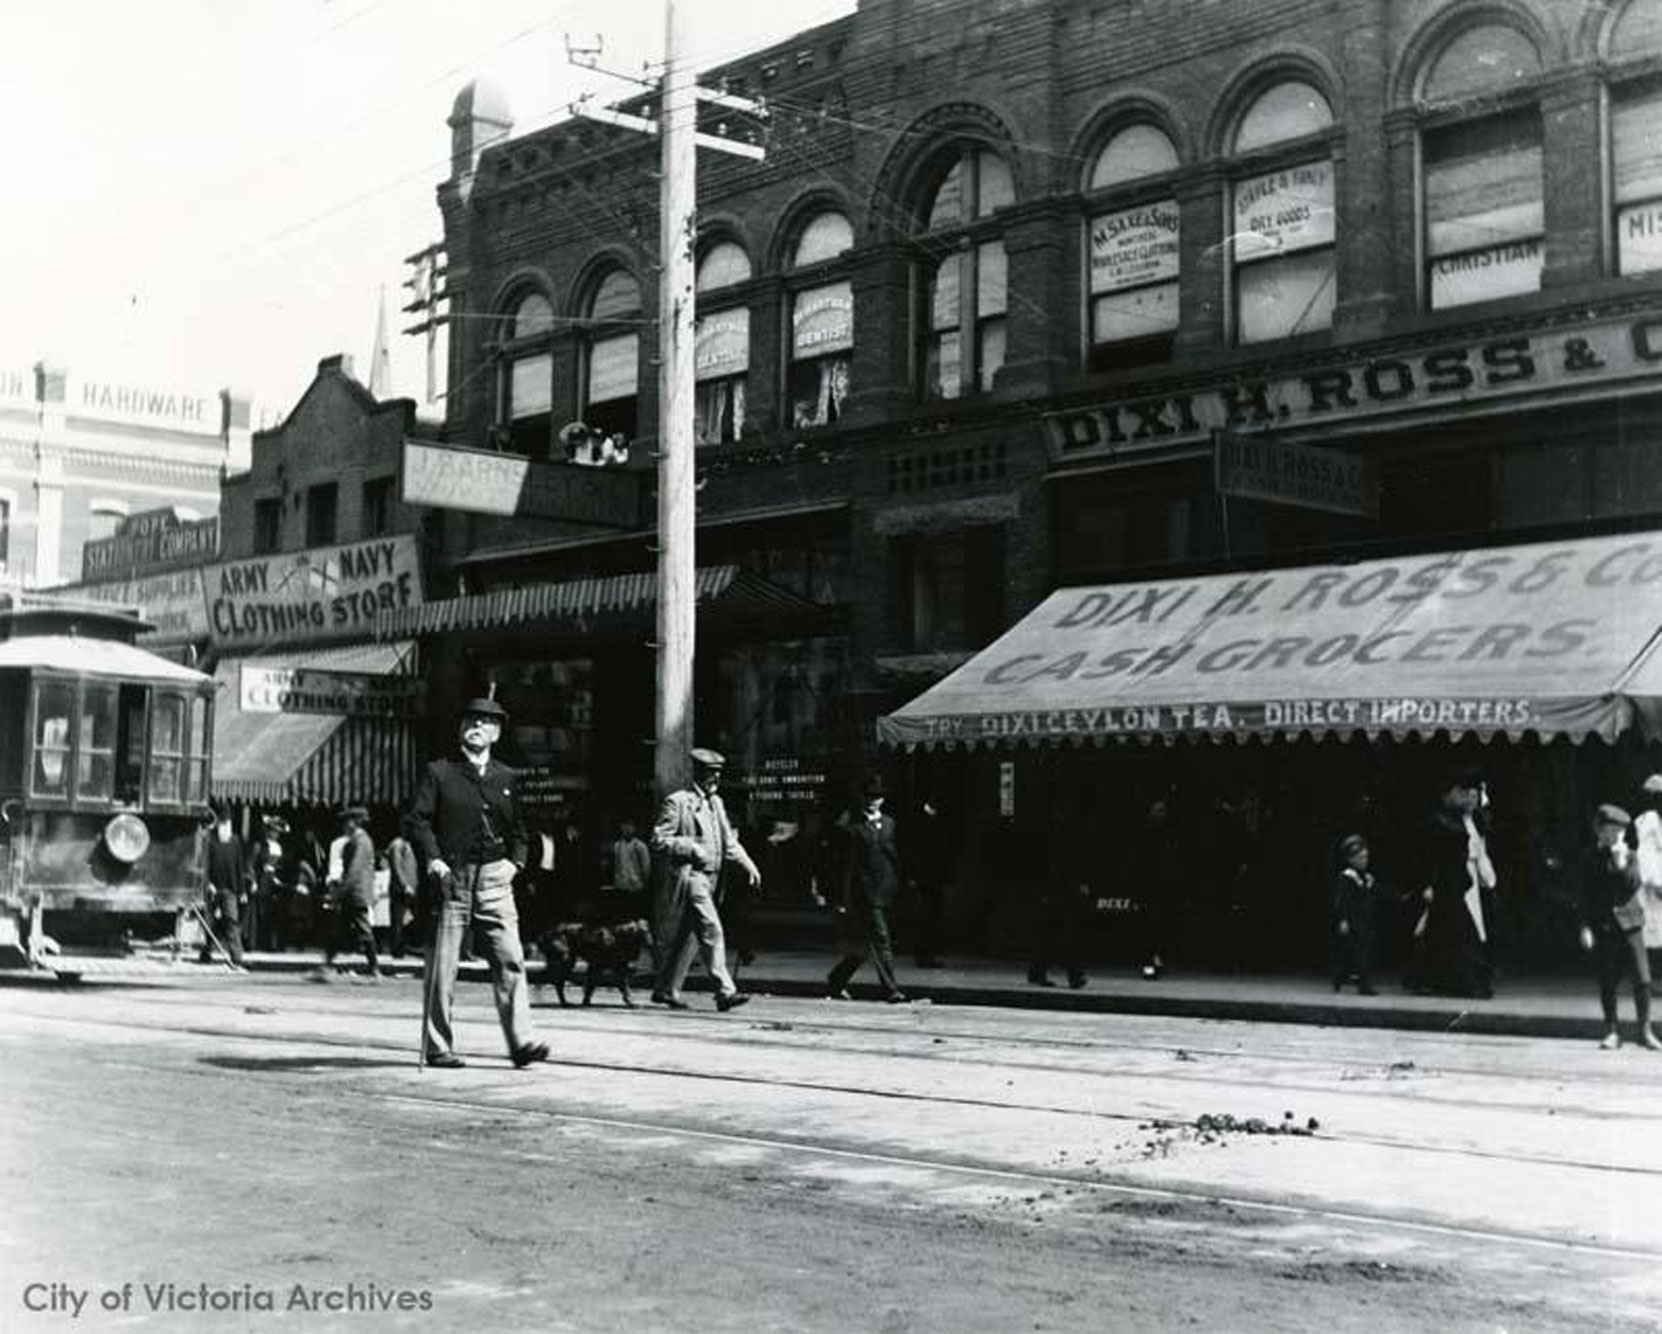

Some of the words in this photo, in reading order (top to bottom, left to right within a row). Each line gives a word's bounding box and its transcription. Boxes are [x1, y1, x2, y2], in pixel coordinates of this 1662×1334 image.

[1250, 214, 1273, 232] DRY
[1438, 242, 1539, 276] CHRISTIAN
[82, 380, 208, 422] HARDWARE
[1062, 396, 1202, 451] DIXI
[1307, 337, 1537, 411] ROSS
[1563, 337, 1605, 371] &
[221, 563, 269, 595] ARMY
[339, 543, 395, 579] NAVY
[1054, 585, 1201, 629] DIXI
[1204, 578, 1275, 618] H.
[1281, 556, 1514, 612] ROSS
[1508, 549, 1578, 595] &
[213, 598, 324, 636] CLOTHING
[332, 572, 411, 624] STORE
[983, 642, 1198, 686] CASH
[1196, 618, 1601, 674] GROCERS.
[249, 689, 349, 710] CLOTHING
[1045, 707, 1161, 734] CEYLON
[1264, 700, 1361, 727] DIRECT
